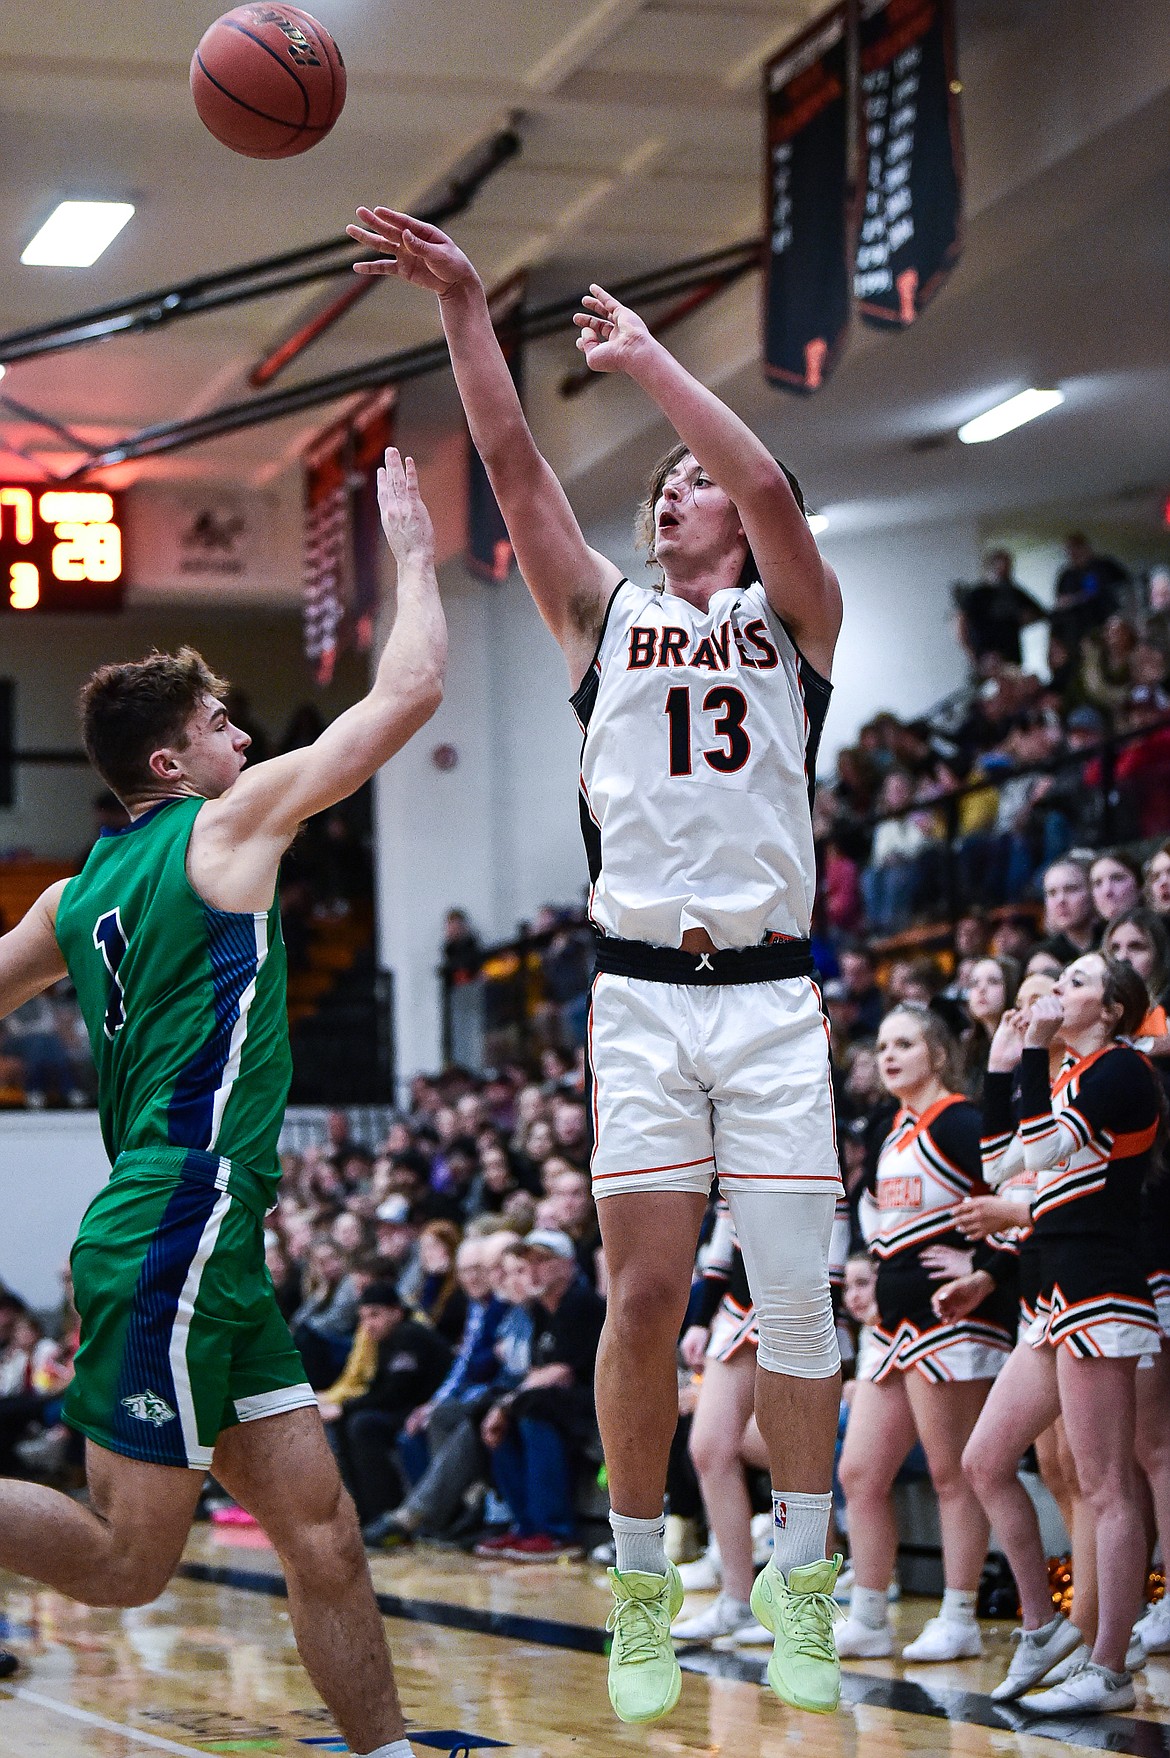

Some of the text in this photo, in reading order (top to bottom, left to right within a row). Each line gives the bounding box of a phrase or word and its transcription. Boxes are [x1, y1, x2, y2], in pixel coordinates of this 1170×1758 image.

[0, 488, 33, 545] 7
[52, 522, 122, 582] 28
[10, 562, 40, 609] 3
[626, 619, 779, 671] BRAVES
[664, 685, 751, 777] 13
[92, 905, 130, 1041] 1
